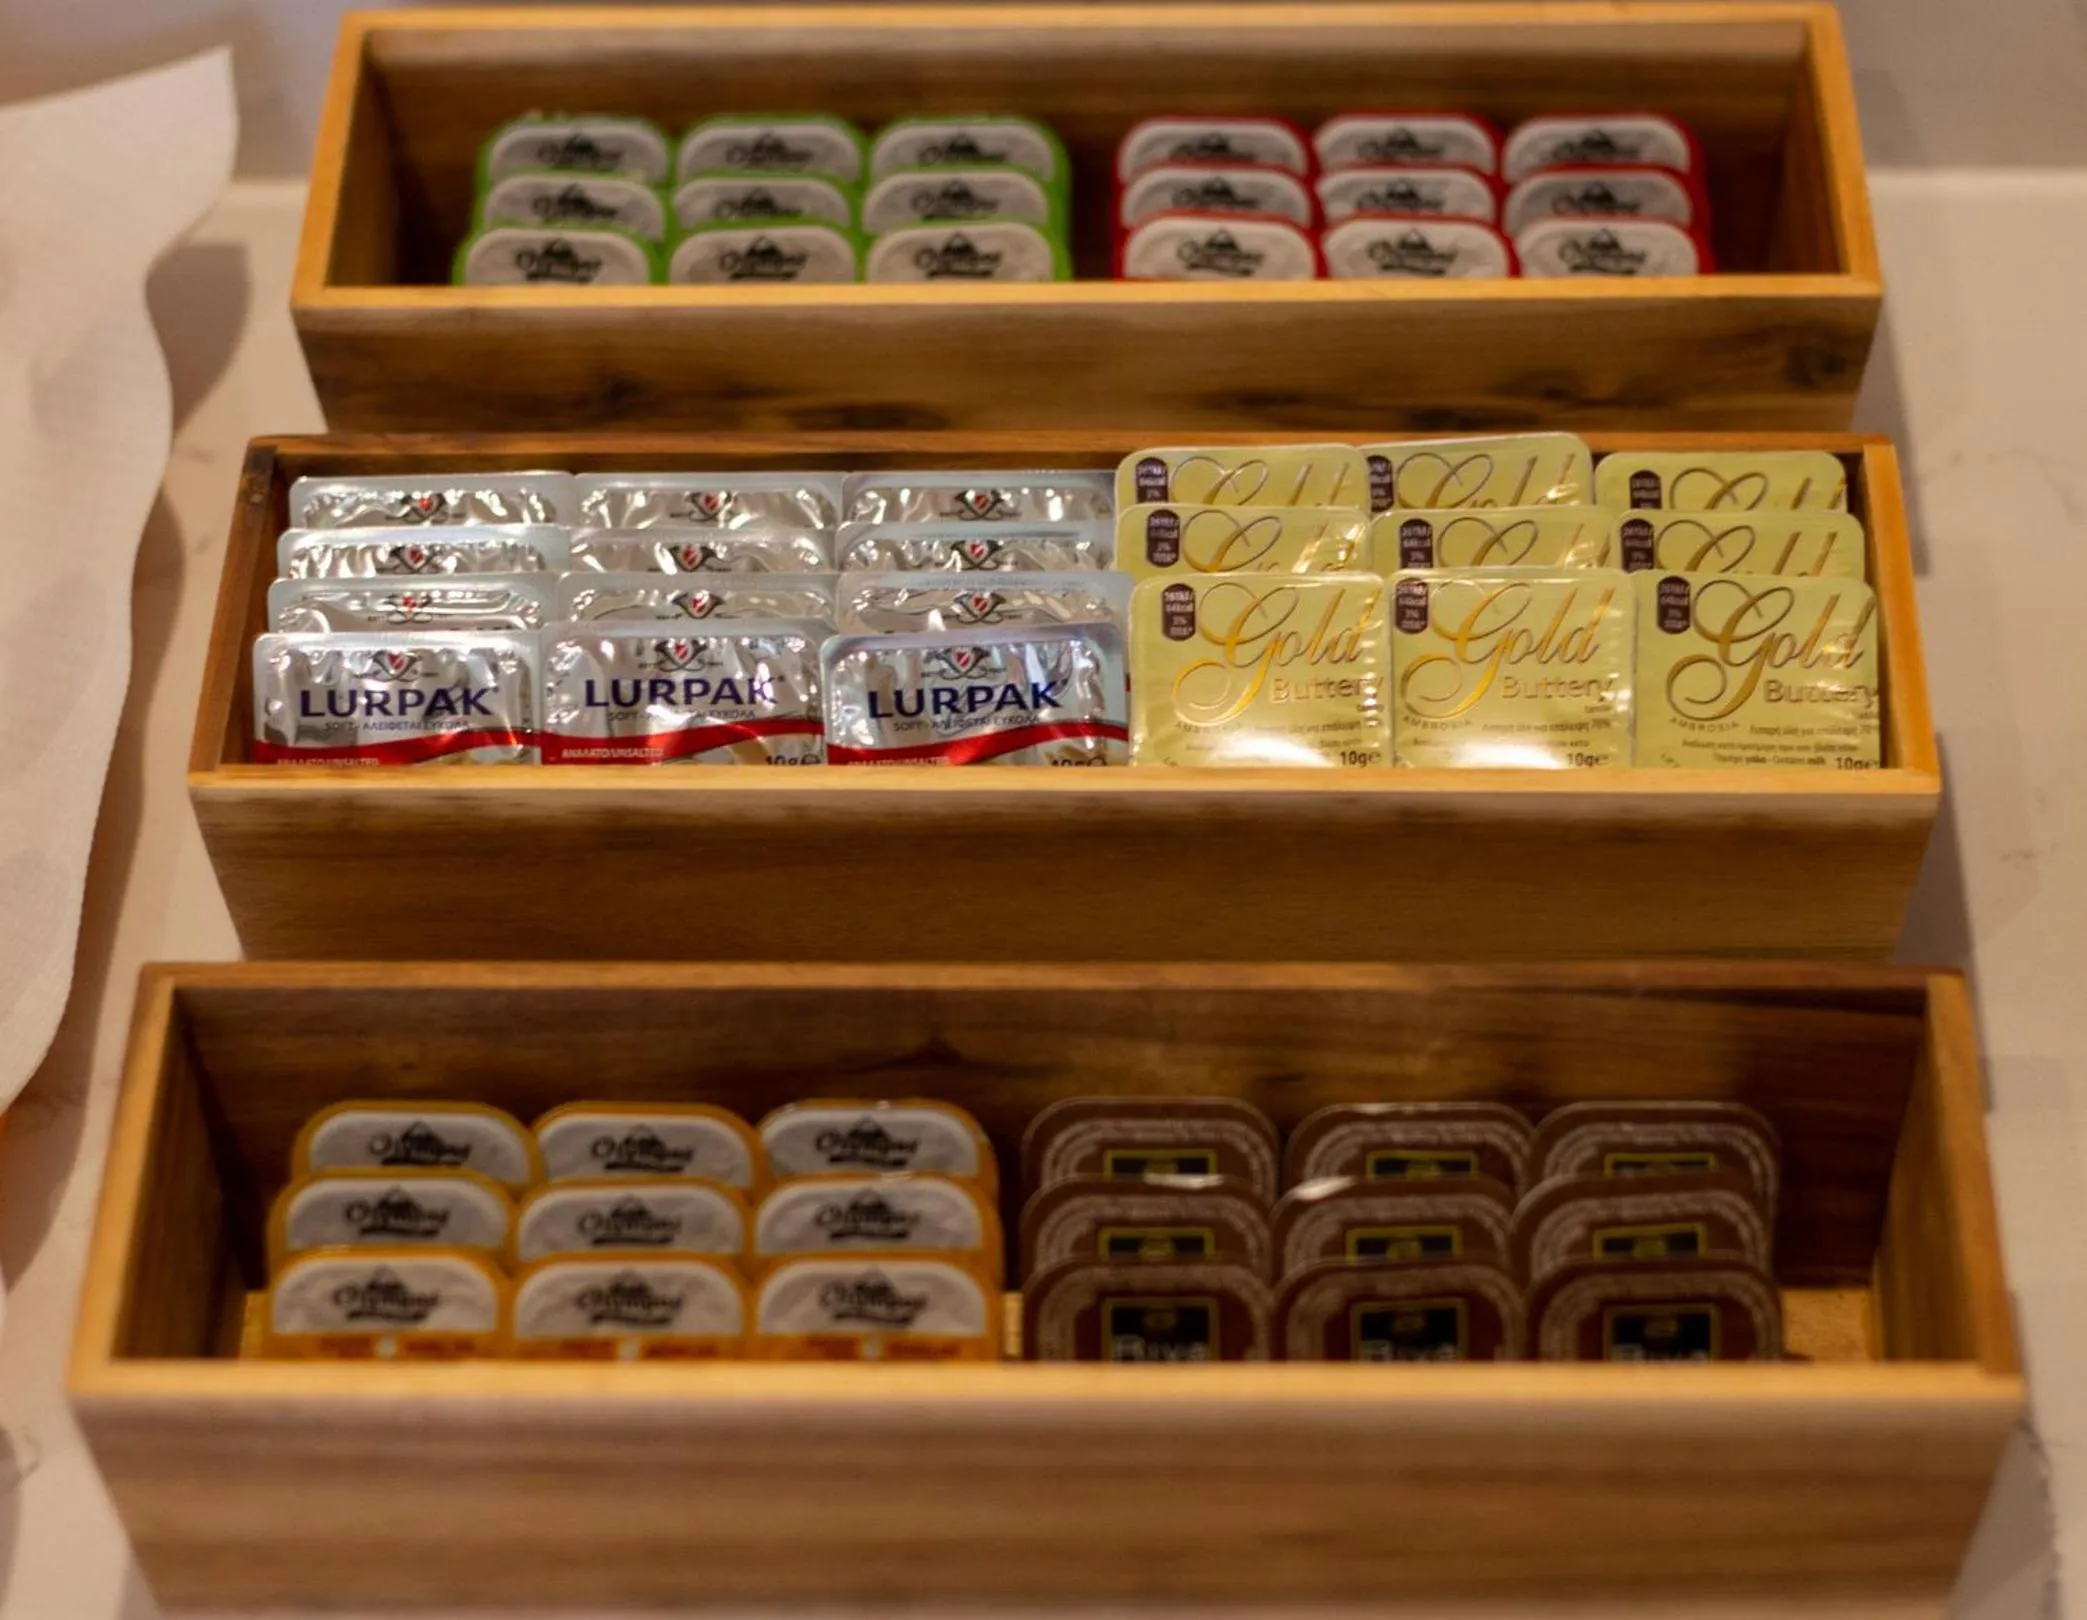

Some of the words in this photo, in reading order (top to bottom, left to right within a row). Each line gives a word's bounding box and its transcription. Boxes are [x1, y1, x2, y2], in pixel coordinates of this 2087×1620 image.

[585, 678, 778, 707] LURPAK
[1172, 582, 1382, 727] Gold
[1400, 579, 1616, 720] Gold
[1665, 578, 1878, 722] Gold
[300, 689, 493, 717] LURPAK
[868, 682, 1063, 719] LURPAK
